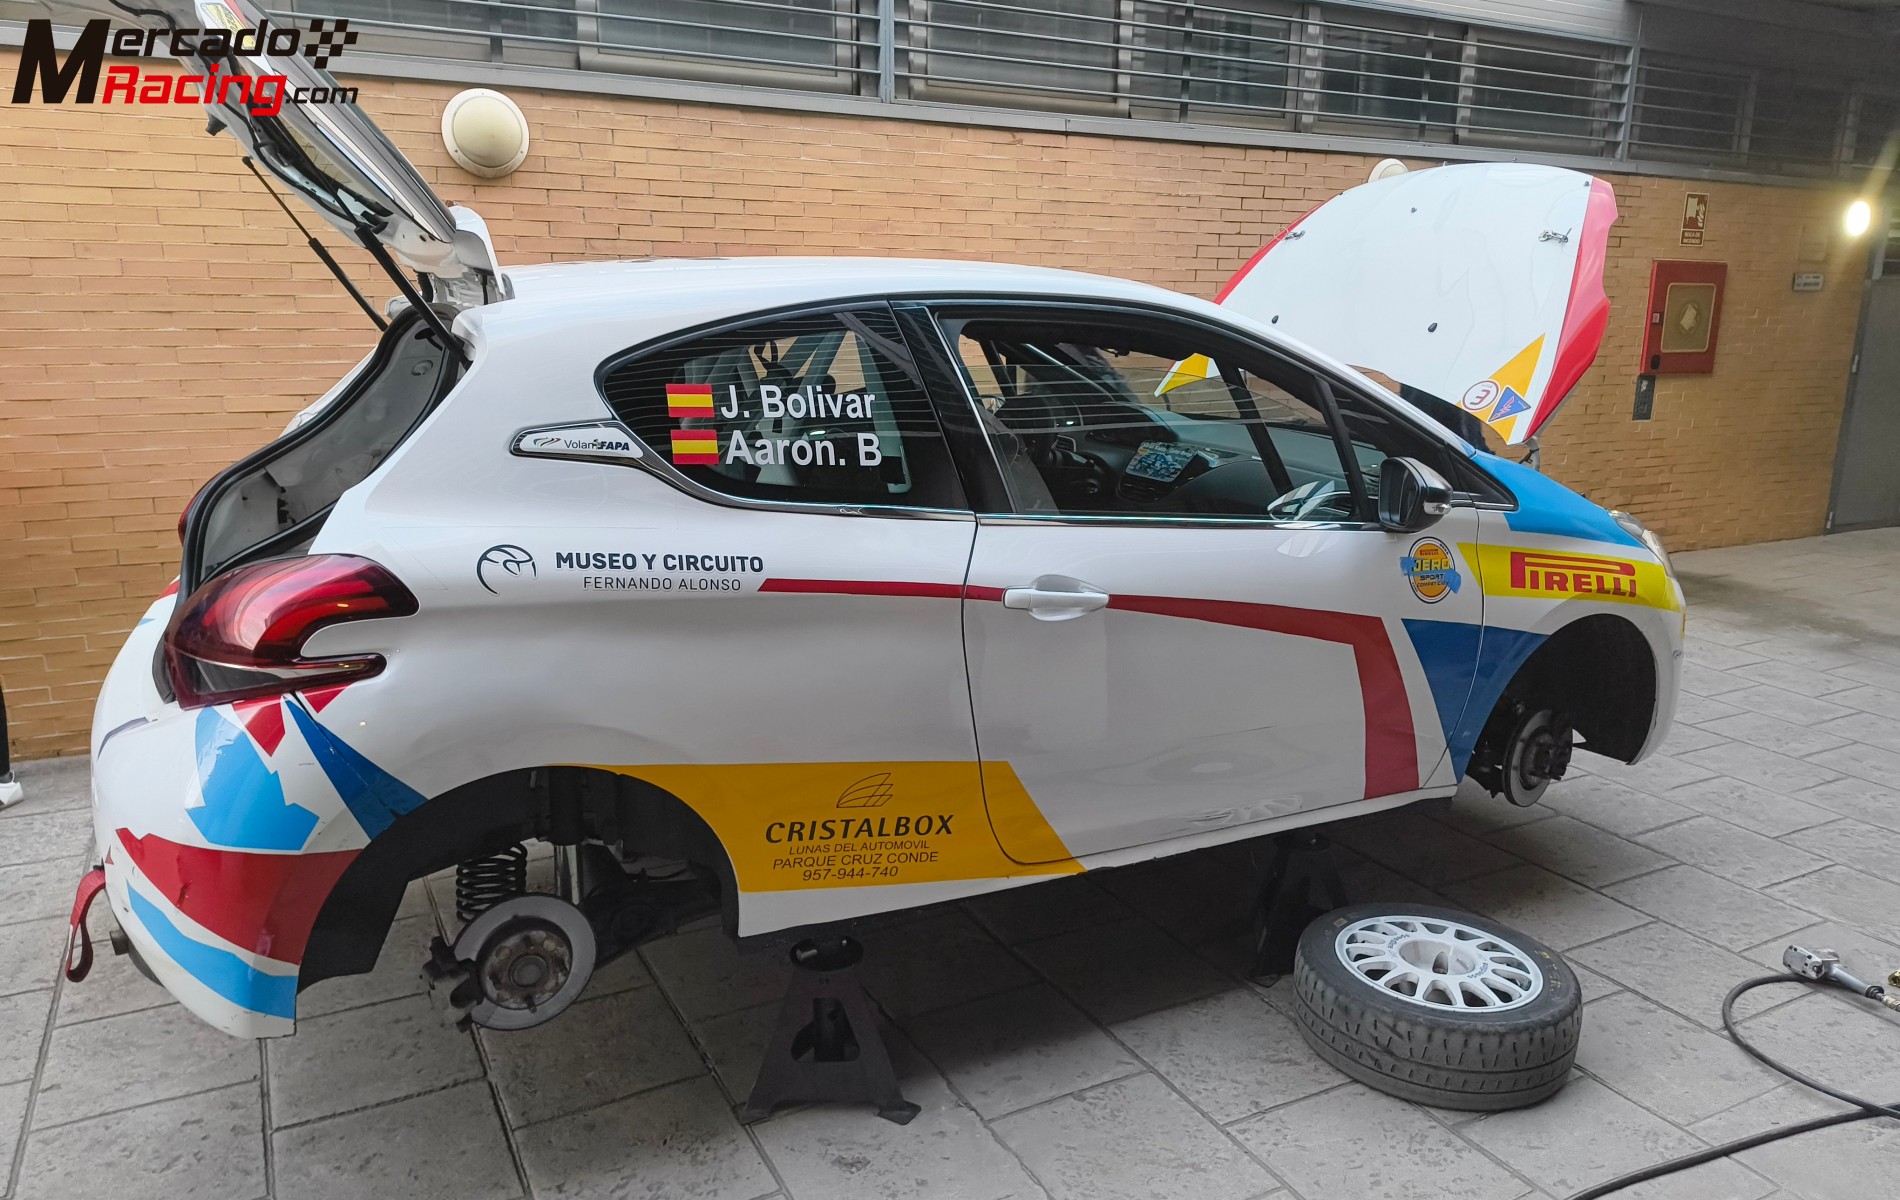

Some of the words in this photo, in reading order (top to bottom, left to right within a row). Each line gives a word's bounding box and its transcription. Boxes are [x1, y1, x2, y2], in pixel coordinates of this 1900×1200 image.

[720, 385, 750, 419] J.
[759, 385, 876, 419] Bolivar
[725, 429, 846, 467] Aaron.
[857, 432, 883, 467] B
[556, 552, 638, 570] MUSEO
[641, 553, 657, 571] Y
[662, 554, 764, 573] CIRCUITO
[583, 576, 673, 590] FERNANDO
[677, 577, 741, 591] ALONSO
[1510, 551, 1637, 598] PIRELLI
[765, 814, 955, 844] CRISTALBOX
[789, 843, 831, 855] LUNAS
[834, 842, 858, 853] DEL
[860, 840, 931, 852] AUTOMOVIL
[772, 854, 837, 870] PARQUE
[840, 853, 883, 866] CRUZ
[887, 851, 939, 865] CONDE
[802, 865, 899, 882] 957-944-740
